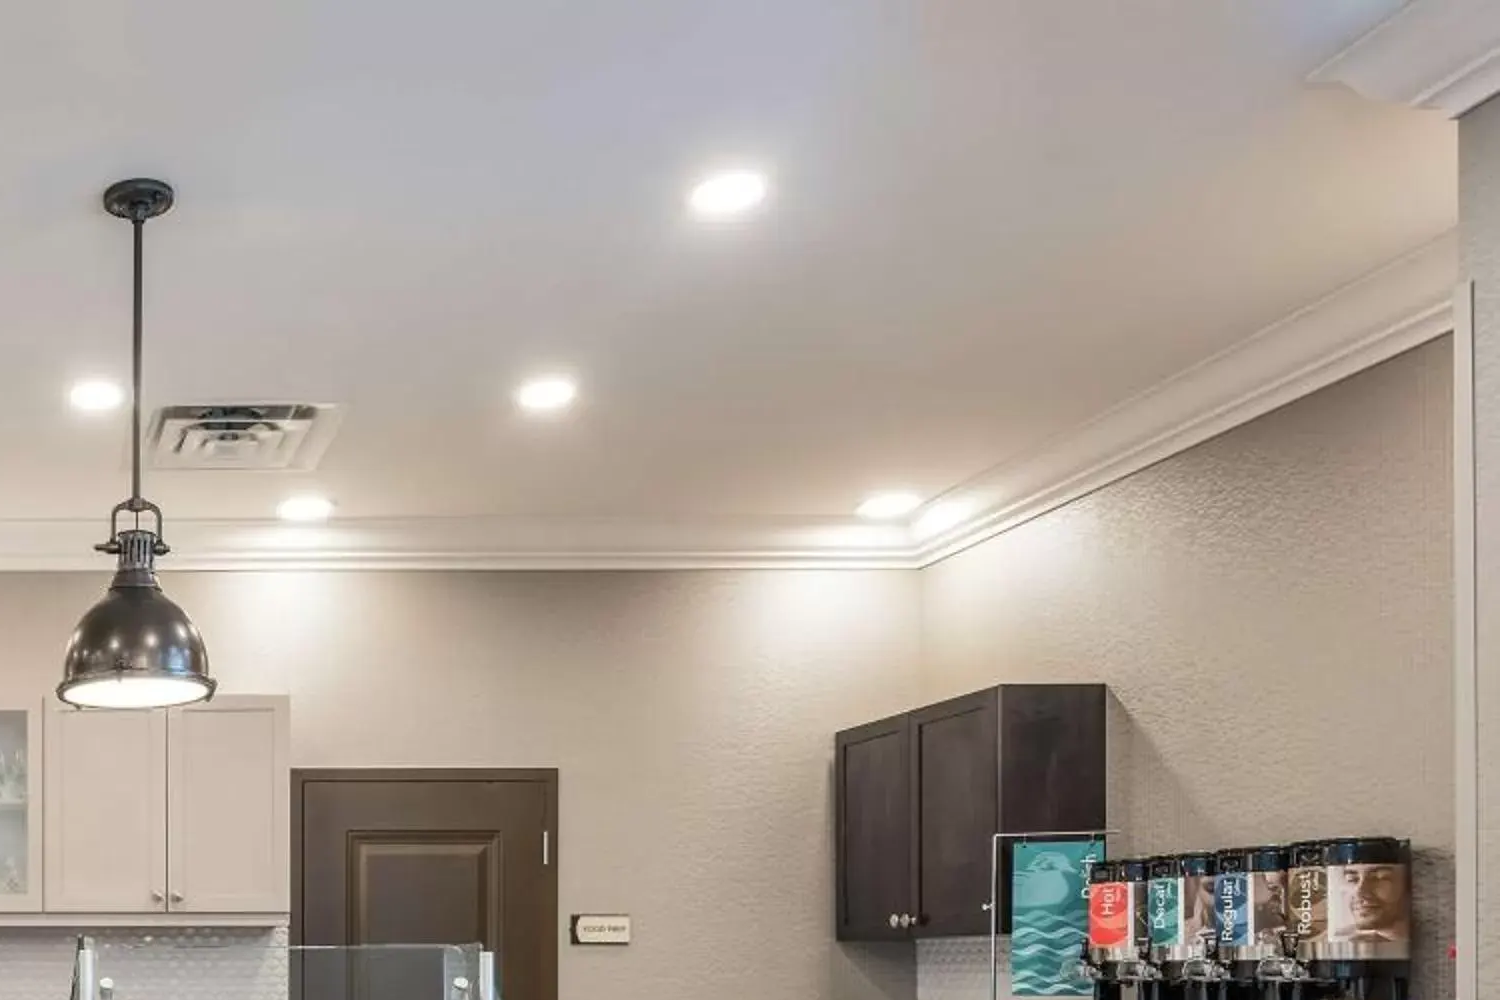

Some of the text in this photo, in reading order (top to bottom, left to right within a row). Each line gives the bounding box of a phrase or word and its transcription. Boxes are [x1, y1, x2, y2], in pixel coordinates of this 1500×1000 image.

[1101, 888, 1116, 916] Hot
[1153, 882, 1166, 929] Decaf
[1221, 879, 1237, 942] Regular
[1298, 871, 1312, 935] Robust
